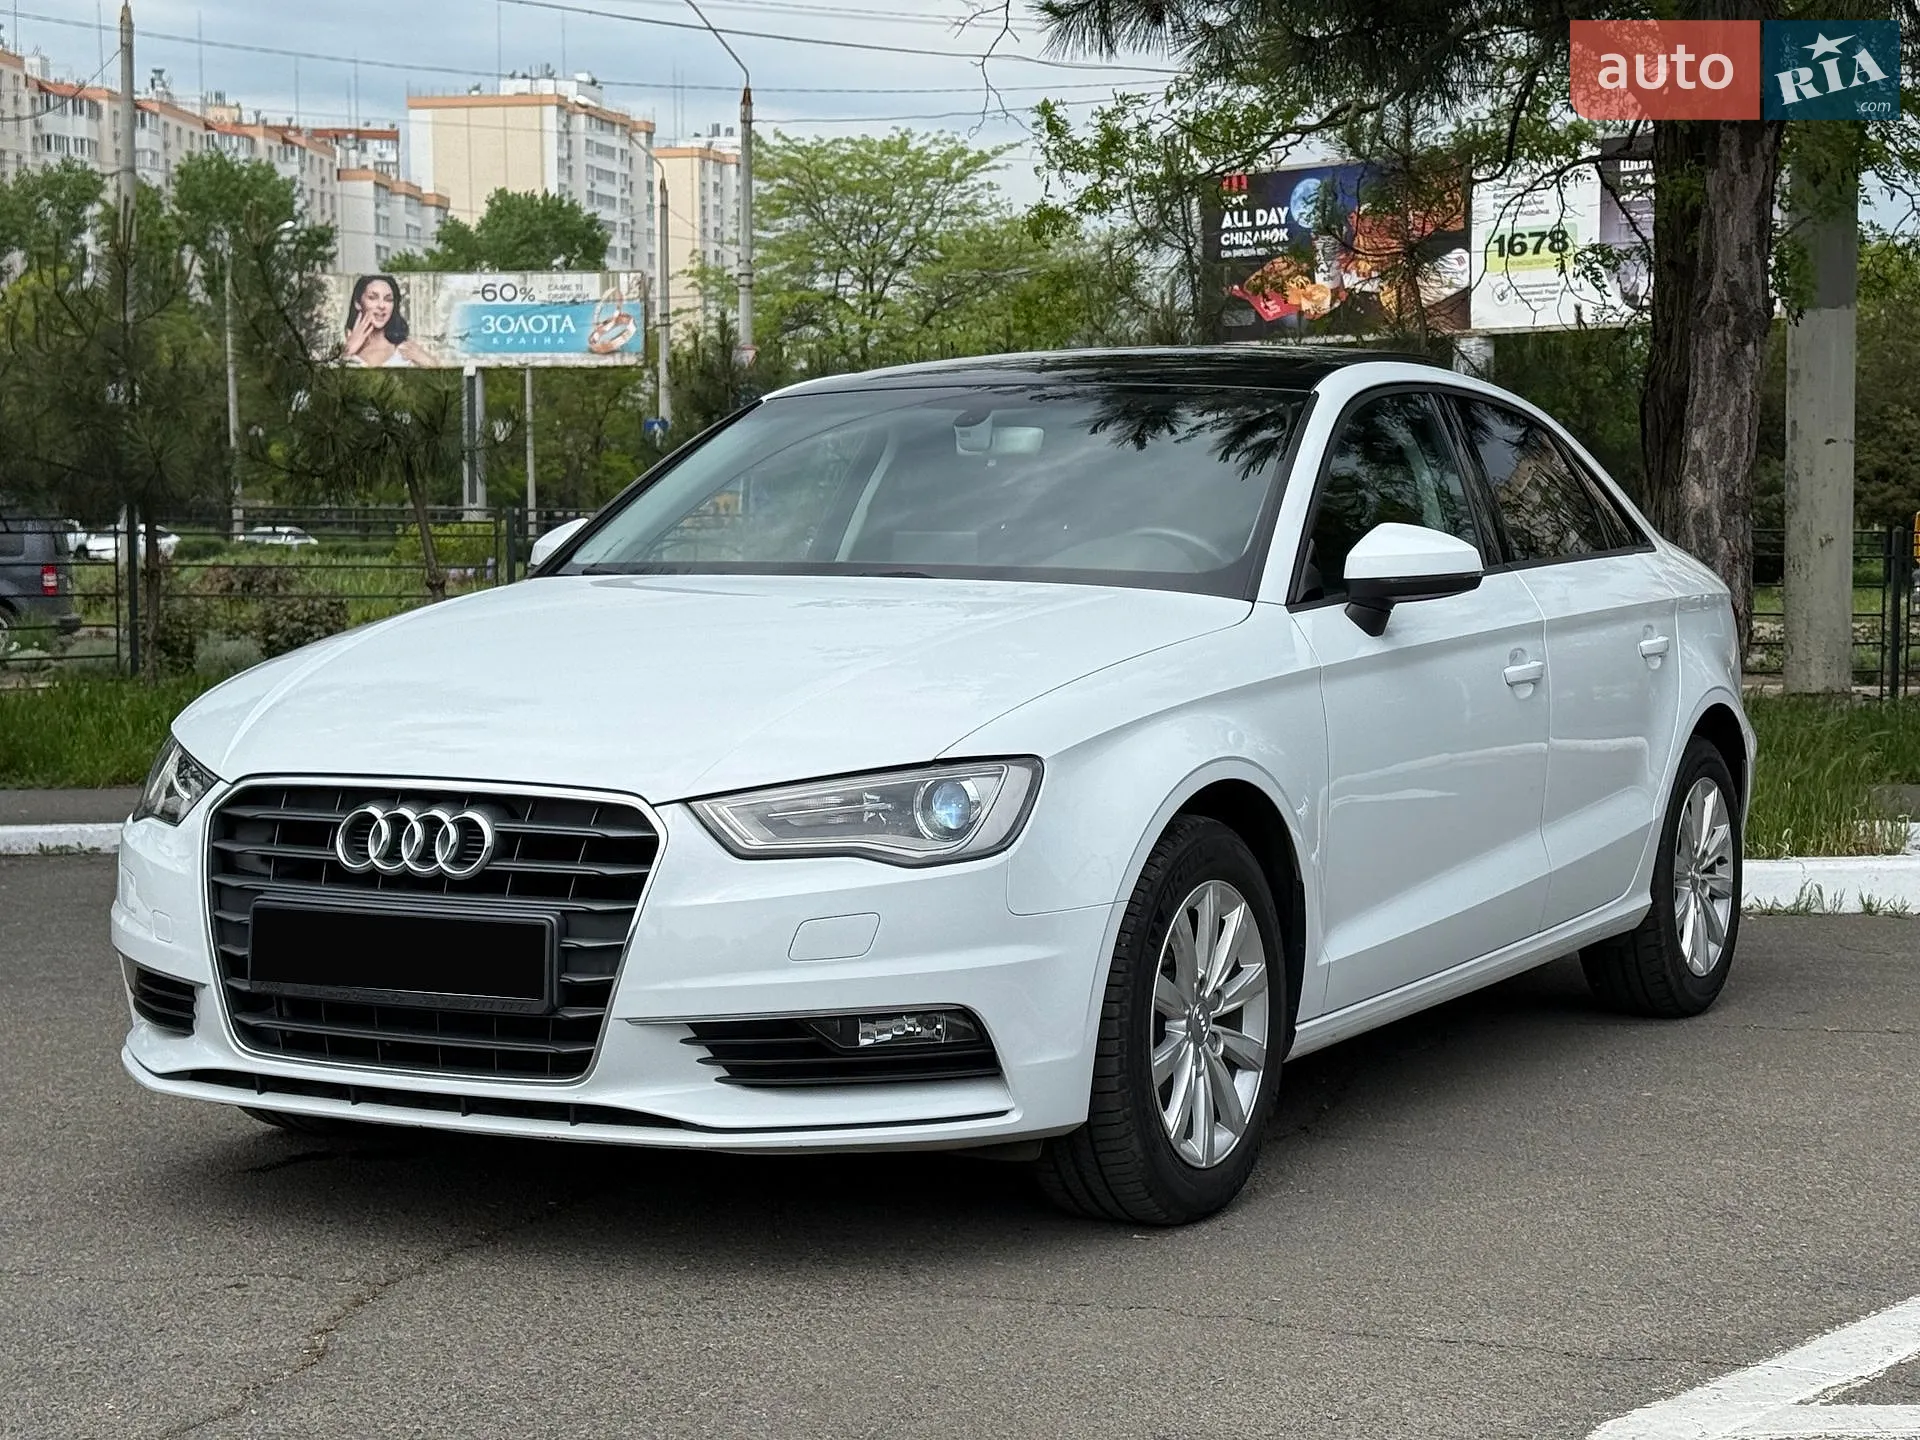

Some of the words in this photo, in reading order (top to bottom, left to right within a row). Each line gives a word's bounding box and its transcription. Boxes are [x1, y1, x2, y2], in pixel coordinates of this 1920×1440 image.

[1221, 210, 1252, 229] ALL
[1255, 206, 1289, 226] DAY
[1493, 230, 1569, 258] 1678
[481, 314, 577, 334] ЗОЛОТА
